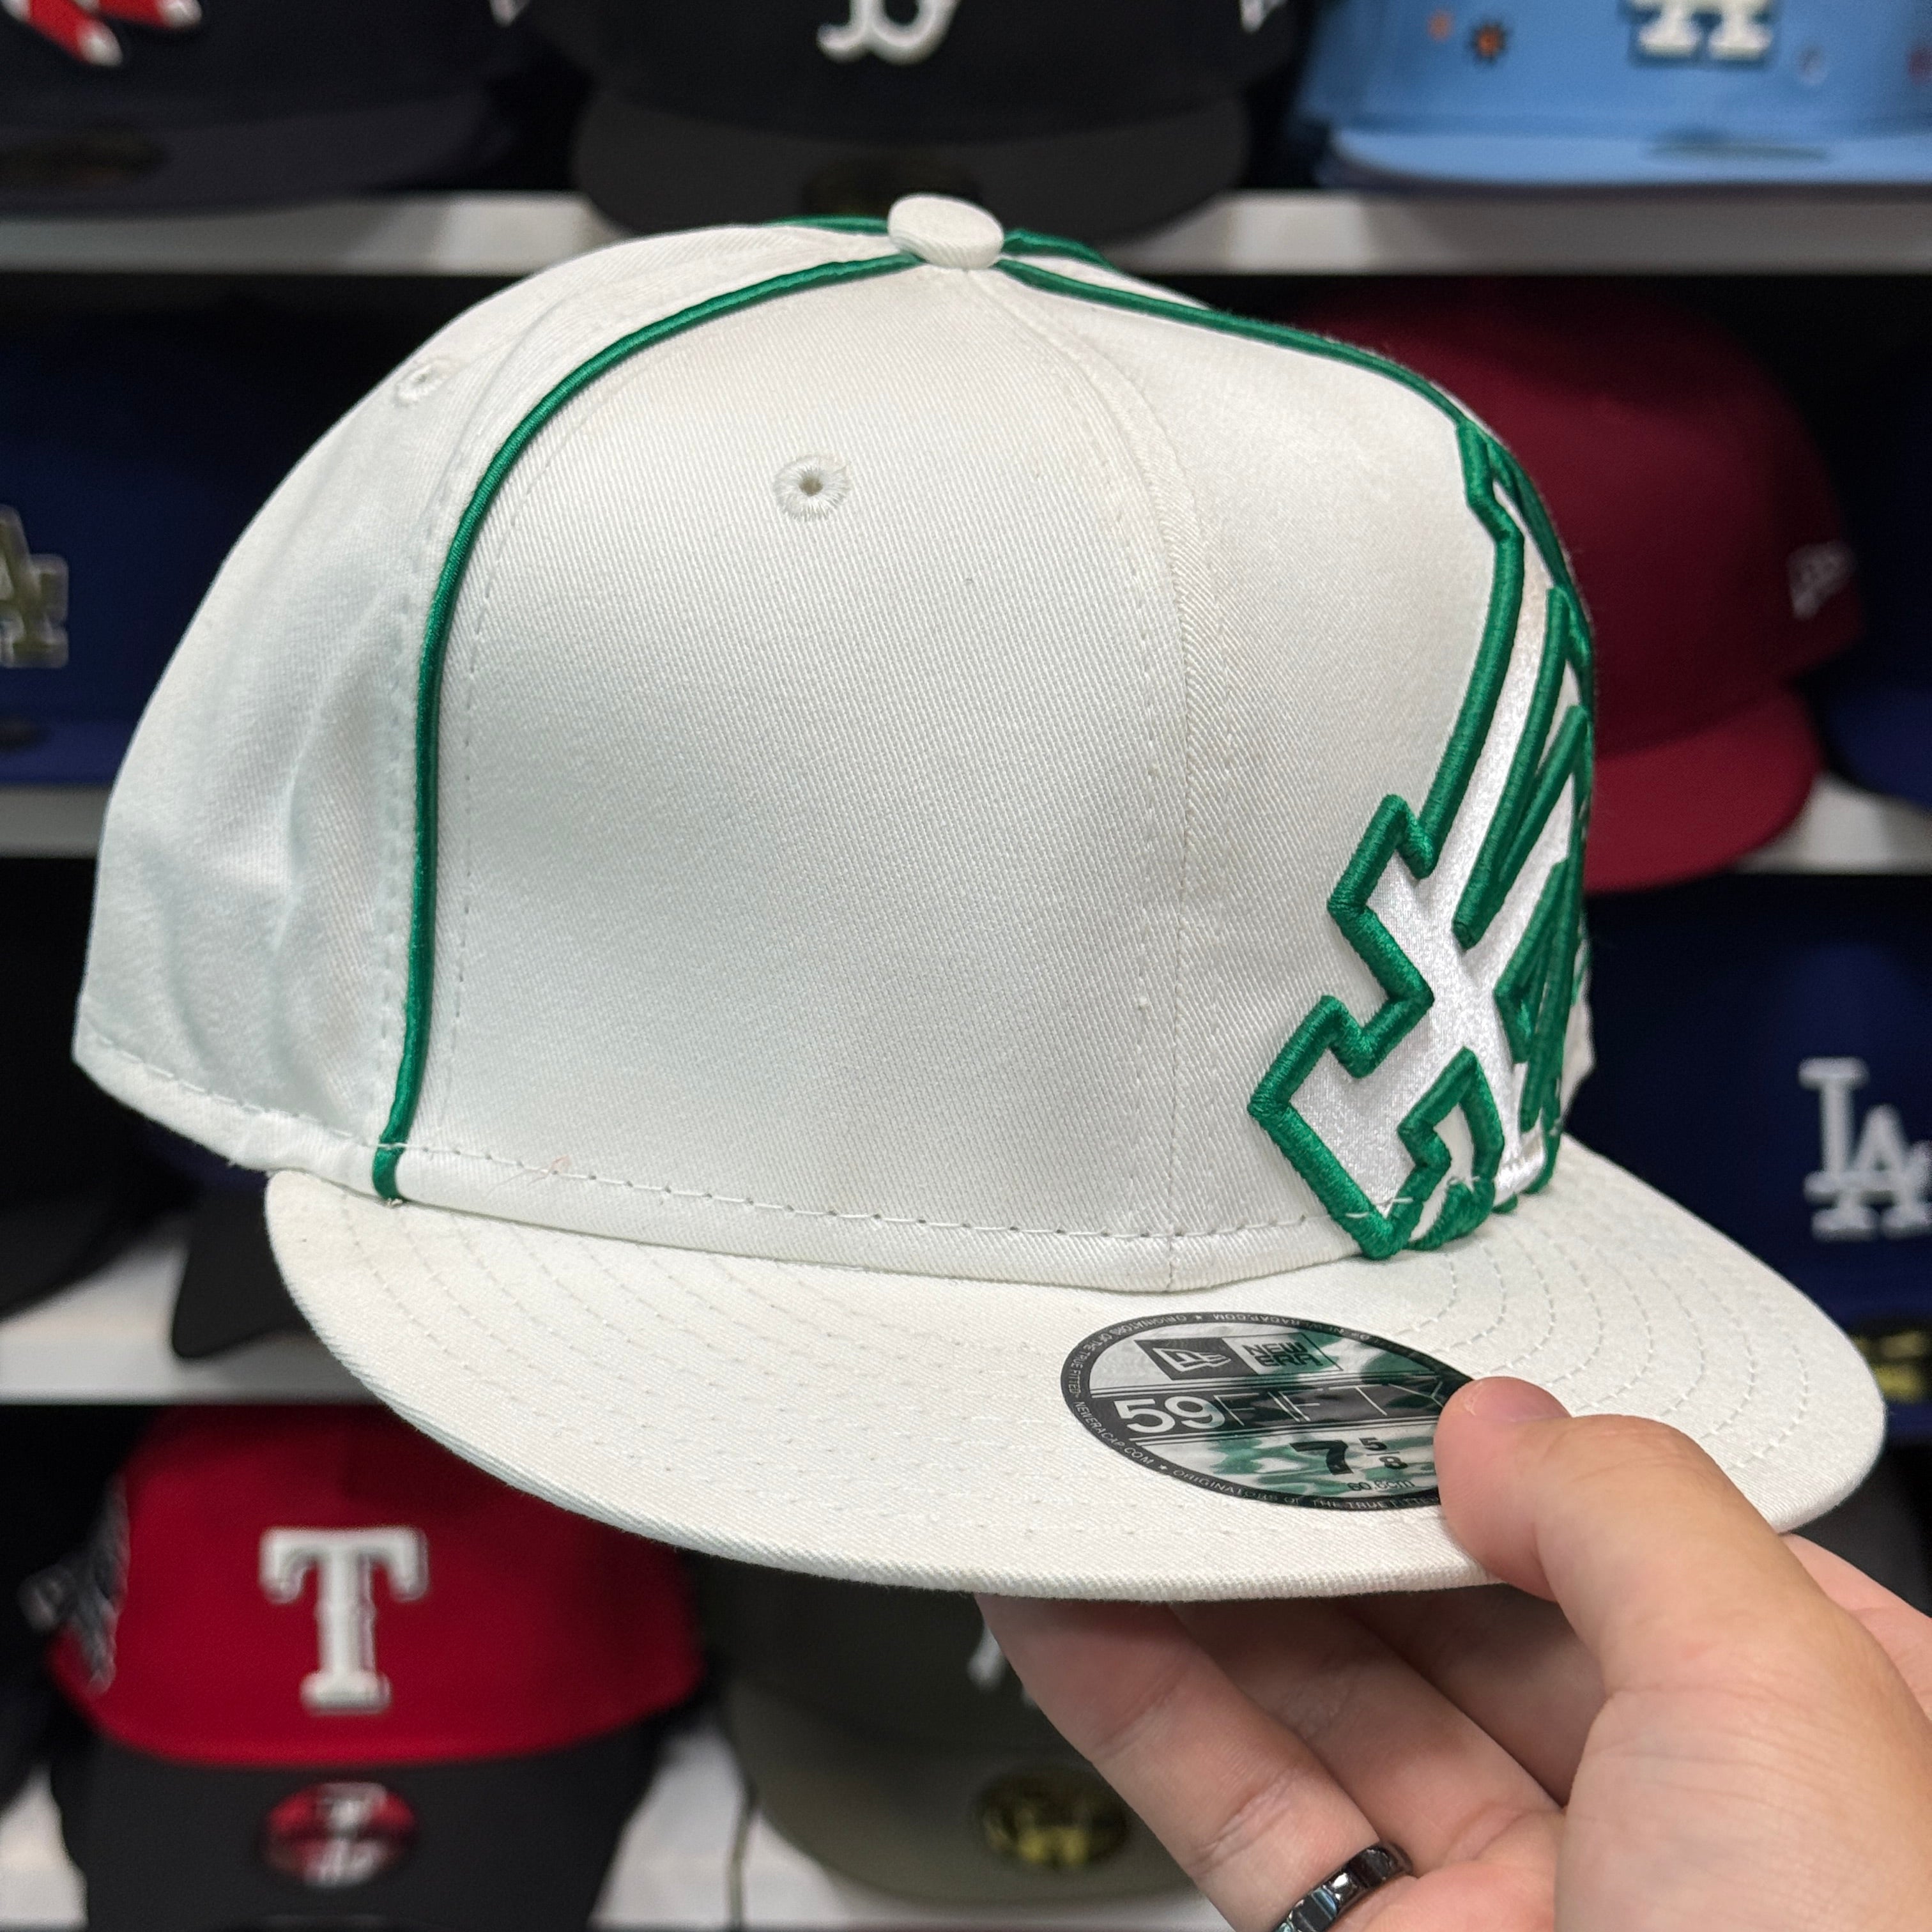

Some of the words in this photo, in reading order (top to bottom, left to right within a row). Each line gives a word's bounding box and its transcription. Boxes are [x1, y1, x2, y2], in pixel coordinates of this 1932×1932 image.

[1797, 1055, 1932, 1241] LA
[1241, 1341, 1308, 1356] NEW
[1254, 1353, 1324, 1367] ERA
[1114, 1381, 1443, 1434] 59FIFTY
[1073, 1401, 1154, 1464] NEWERACAP.COM
[1289, 1439, 1354, 1475] 7
[1347, 1501, 1386, 1509] TRUE
[259, 1526, 429, 1716] T
